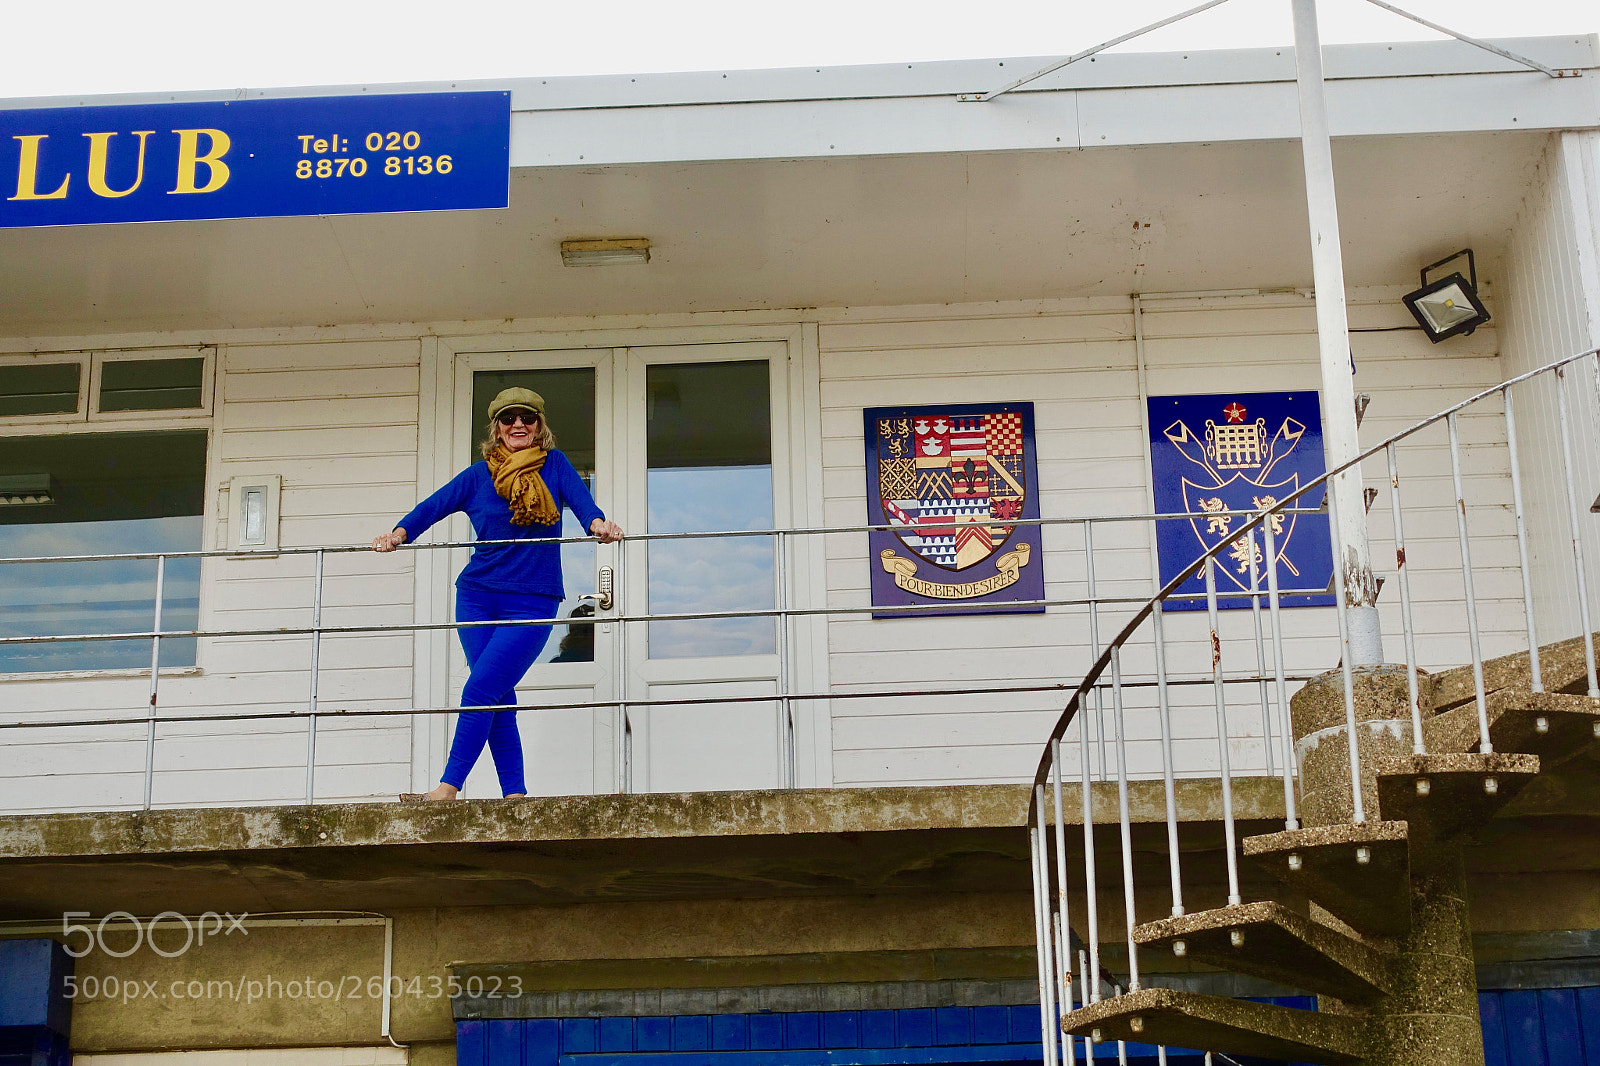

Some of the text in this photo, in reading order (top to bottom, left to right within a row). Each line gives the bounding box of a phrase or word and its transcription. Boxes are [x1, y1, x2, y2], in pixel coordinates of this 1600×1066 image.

[297, 131, 421, 154] Tel: 020
[7, 128, 231, 201] LUB
[295, 154, 453, 179] 8870 8136
